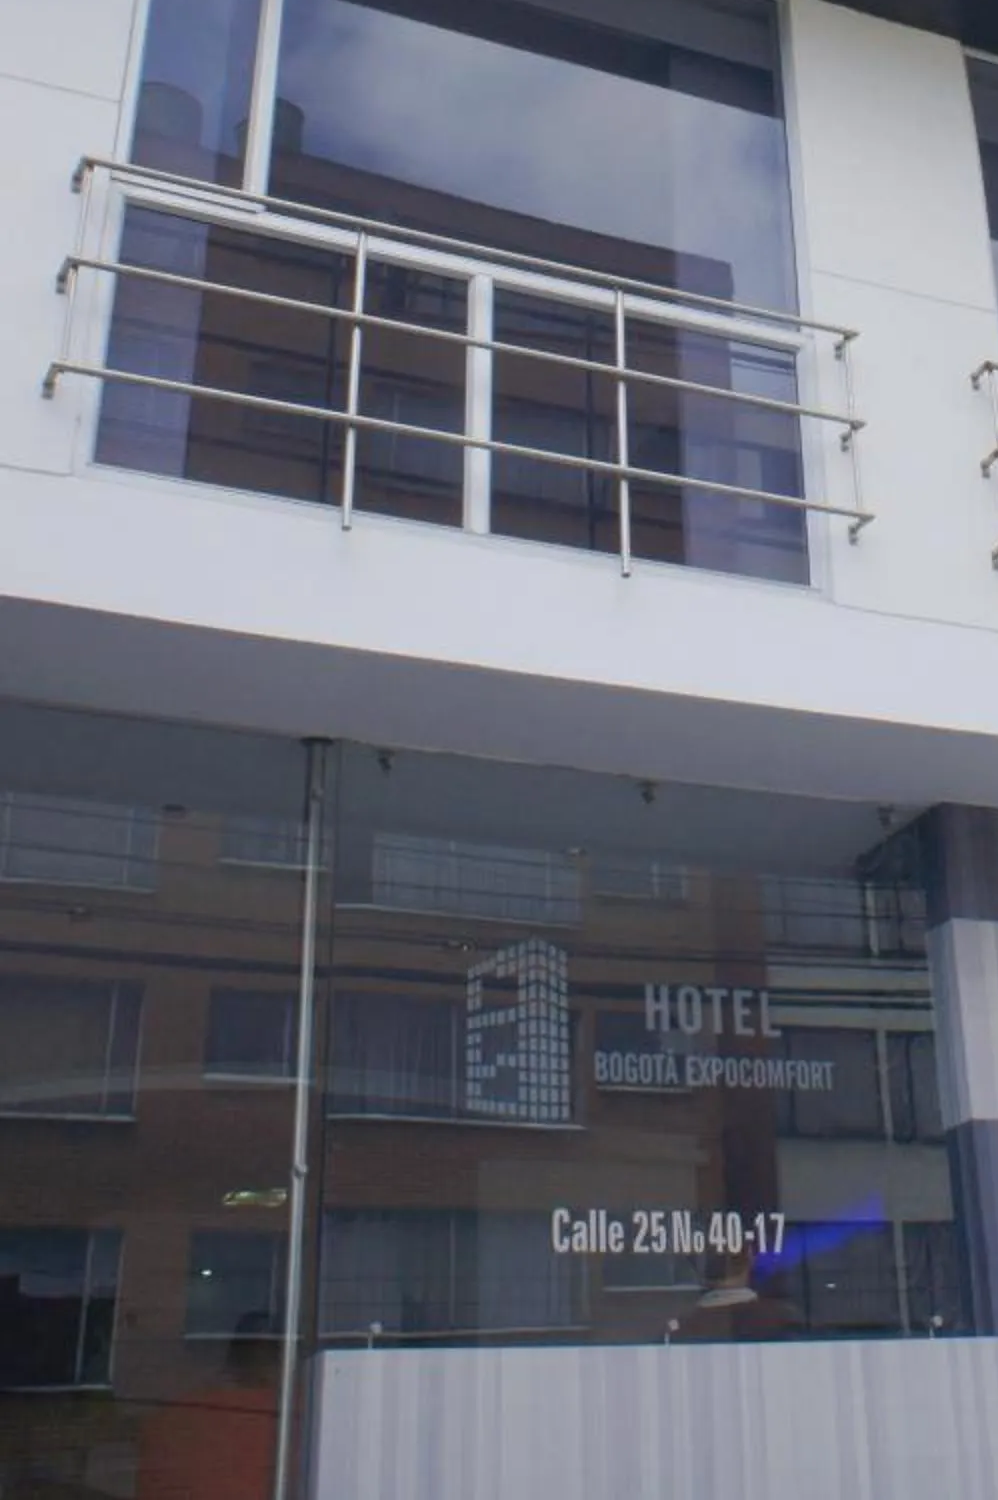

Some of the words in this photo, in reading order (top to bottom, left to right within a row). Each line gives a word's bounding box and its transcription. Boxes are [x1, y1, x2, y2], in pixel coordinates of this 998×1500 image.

[644, 983, 783, 1039] HOTEL
[685, 1056, 835, 1091] EXPOCOMFORT
[551, 1207, 625, 1253] Calle
[632, 1210, 667, 1254] 25
[708, 1211, 785, 1255] 40-17
